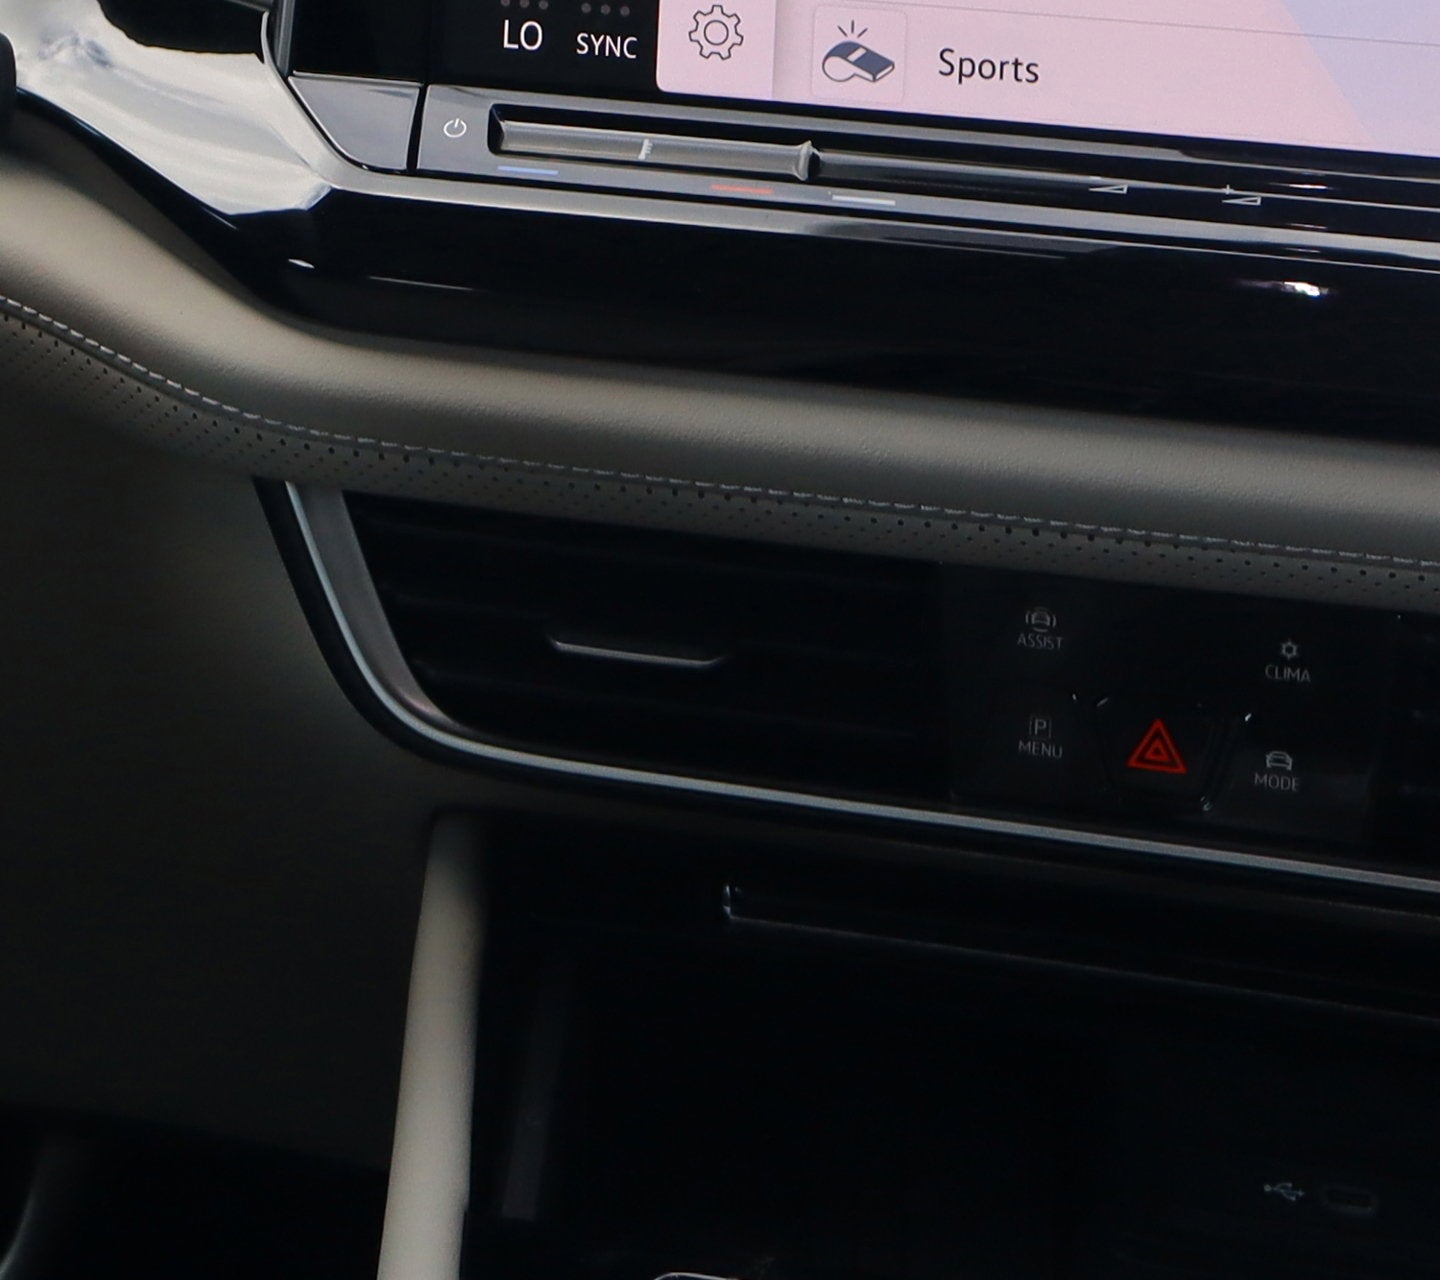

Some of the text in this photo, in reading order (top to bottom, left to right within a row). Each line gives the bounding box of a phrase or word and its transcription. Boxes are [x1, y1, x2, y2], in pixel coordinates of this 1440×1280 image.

[503, 19, 543, 51] LO
[576, 32, 638, 59] SYNC
[938, 47, 1039, 85] Sports
[1016, 632, 1064, 651] ASSIST
[1264, 664, 1311, 682] CLIMA
[1018, 740, 1063, 758] MENU
[1253, 771, 1300, 792] MODE
